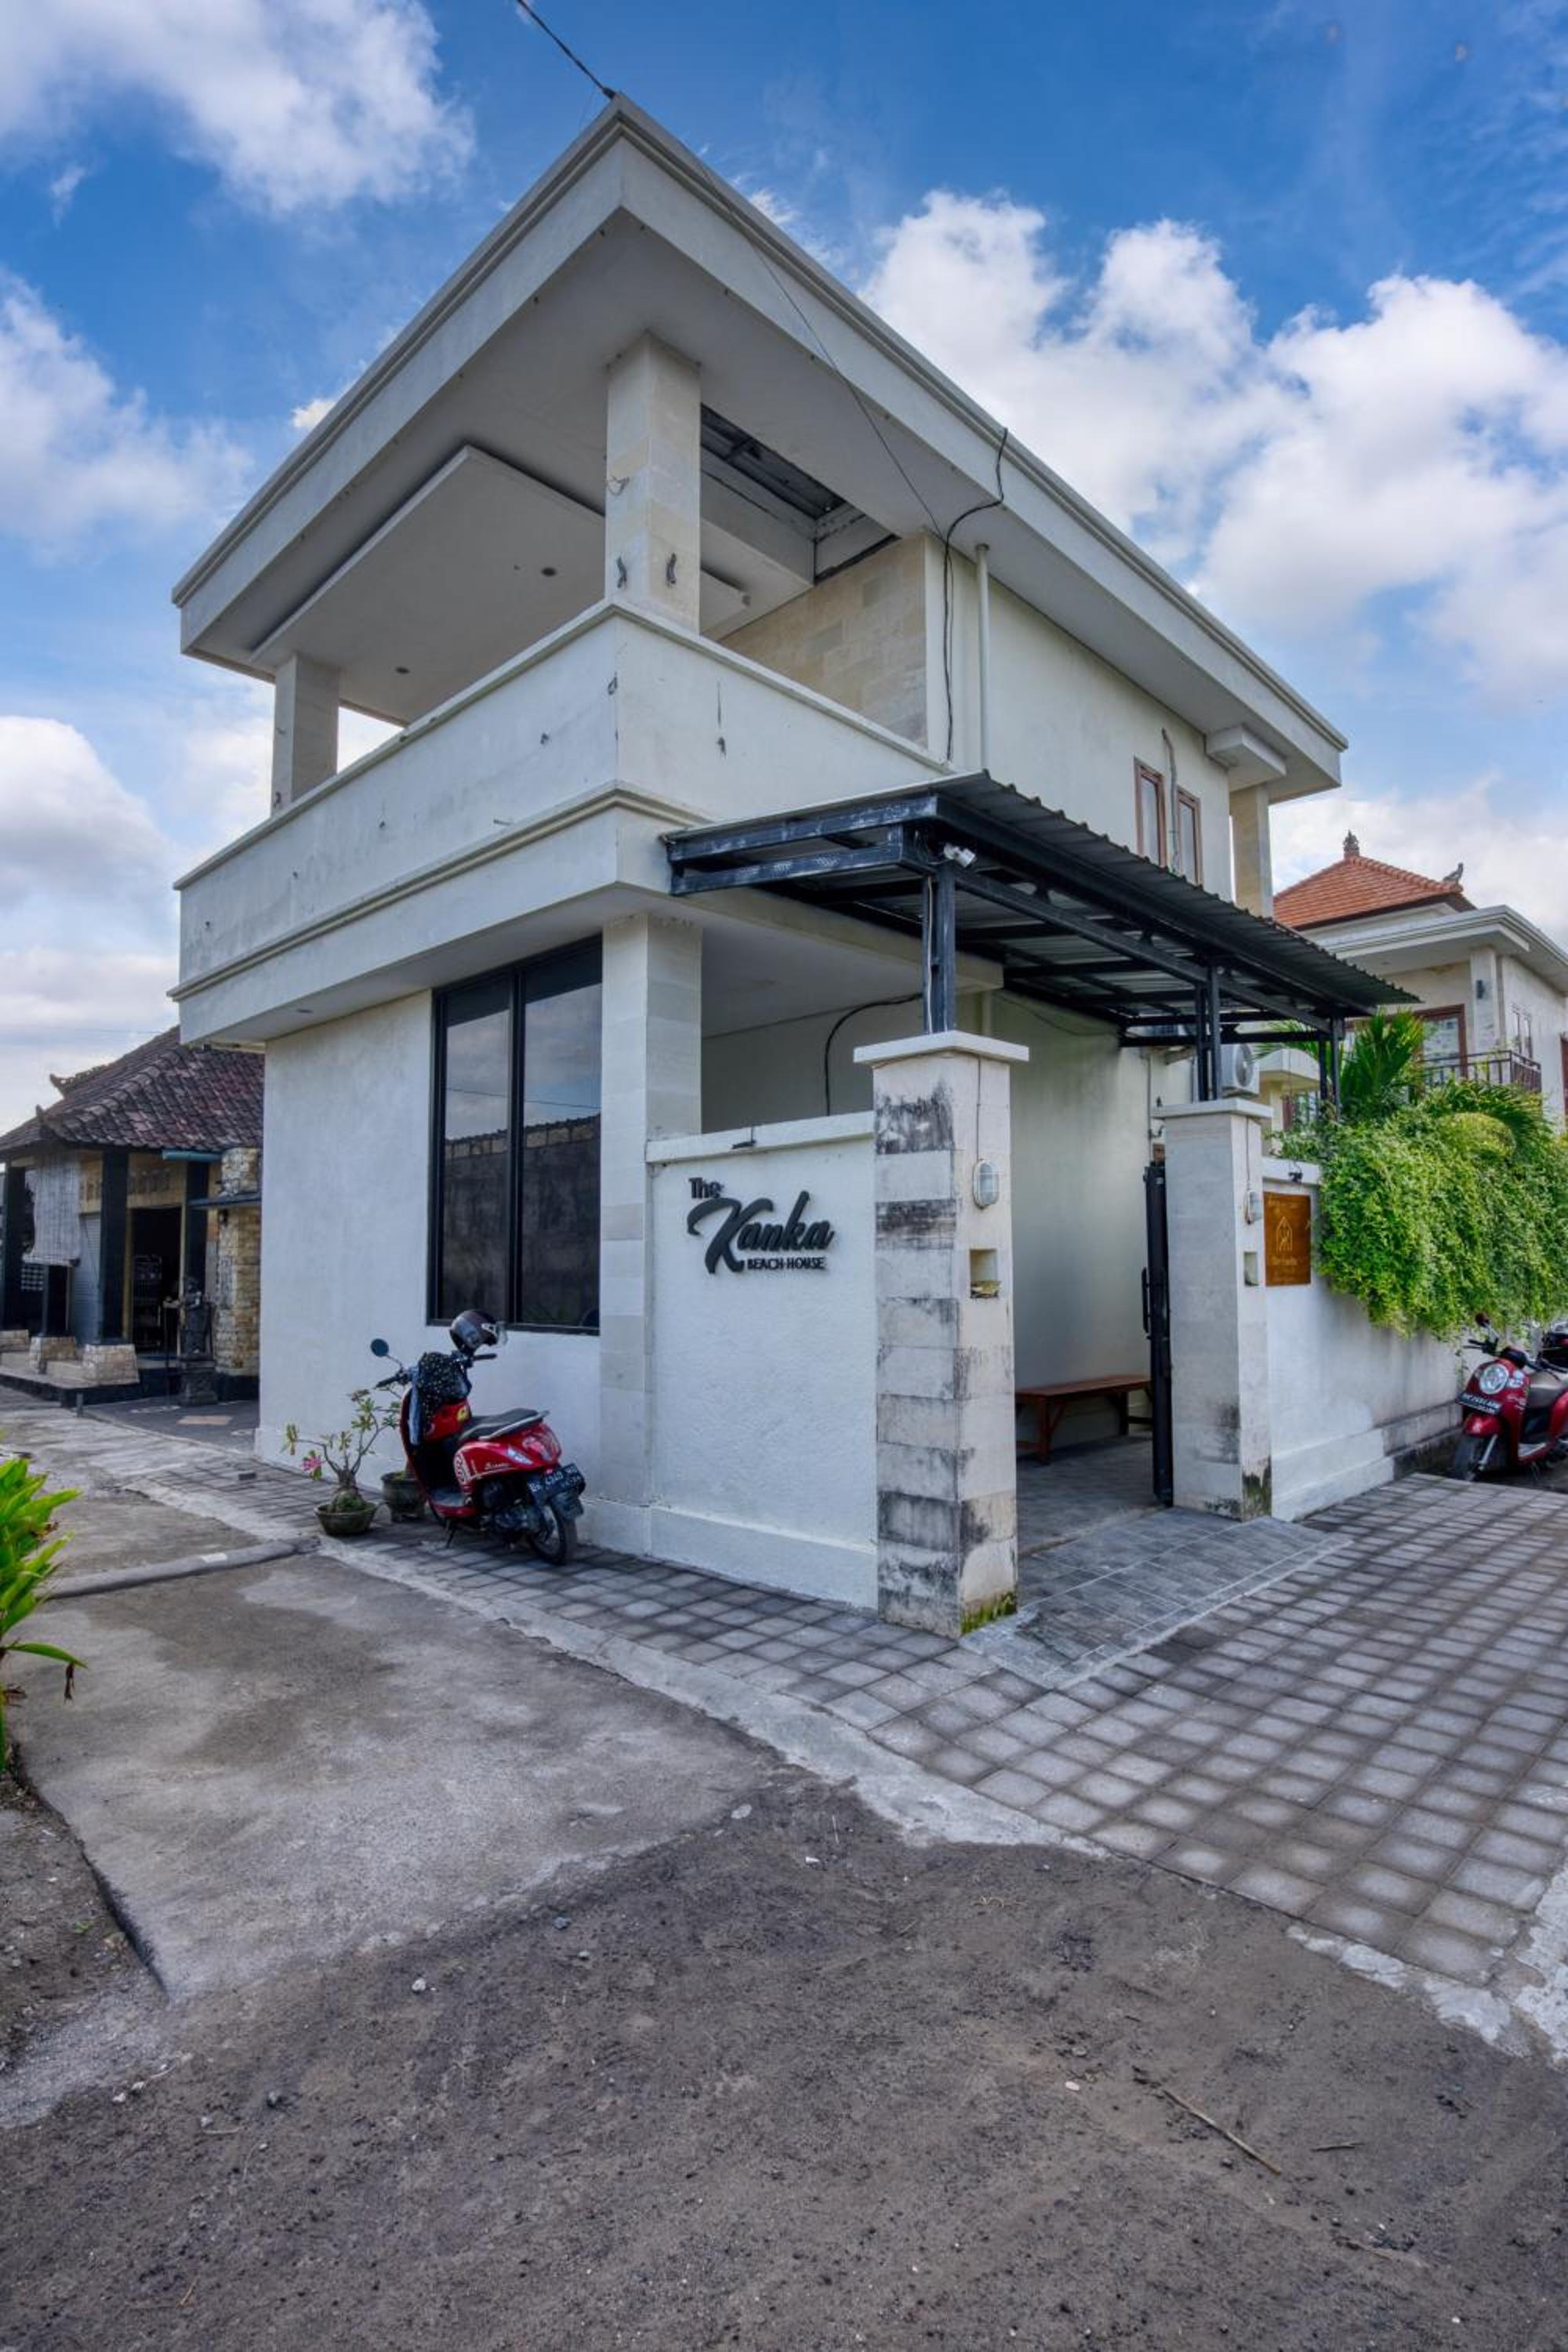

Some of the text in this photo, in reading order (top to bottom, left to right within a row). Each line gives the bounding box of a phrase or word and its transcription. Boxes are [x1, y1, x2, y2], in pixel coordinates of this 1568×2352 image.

[688, 1178, 724, 1199] The
[747, 1256, 826, 1270] BEACH HOUSE
